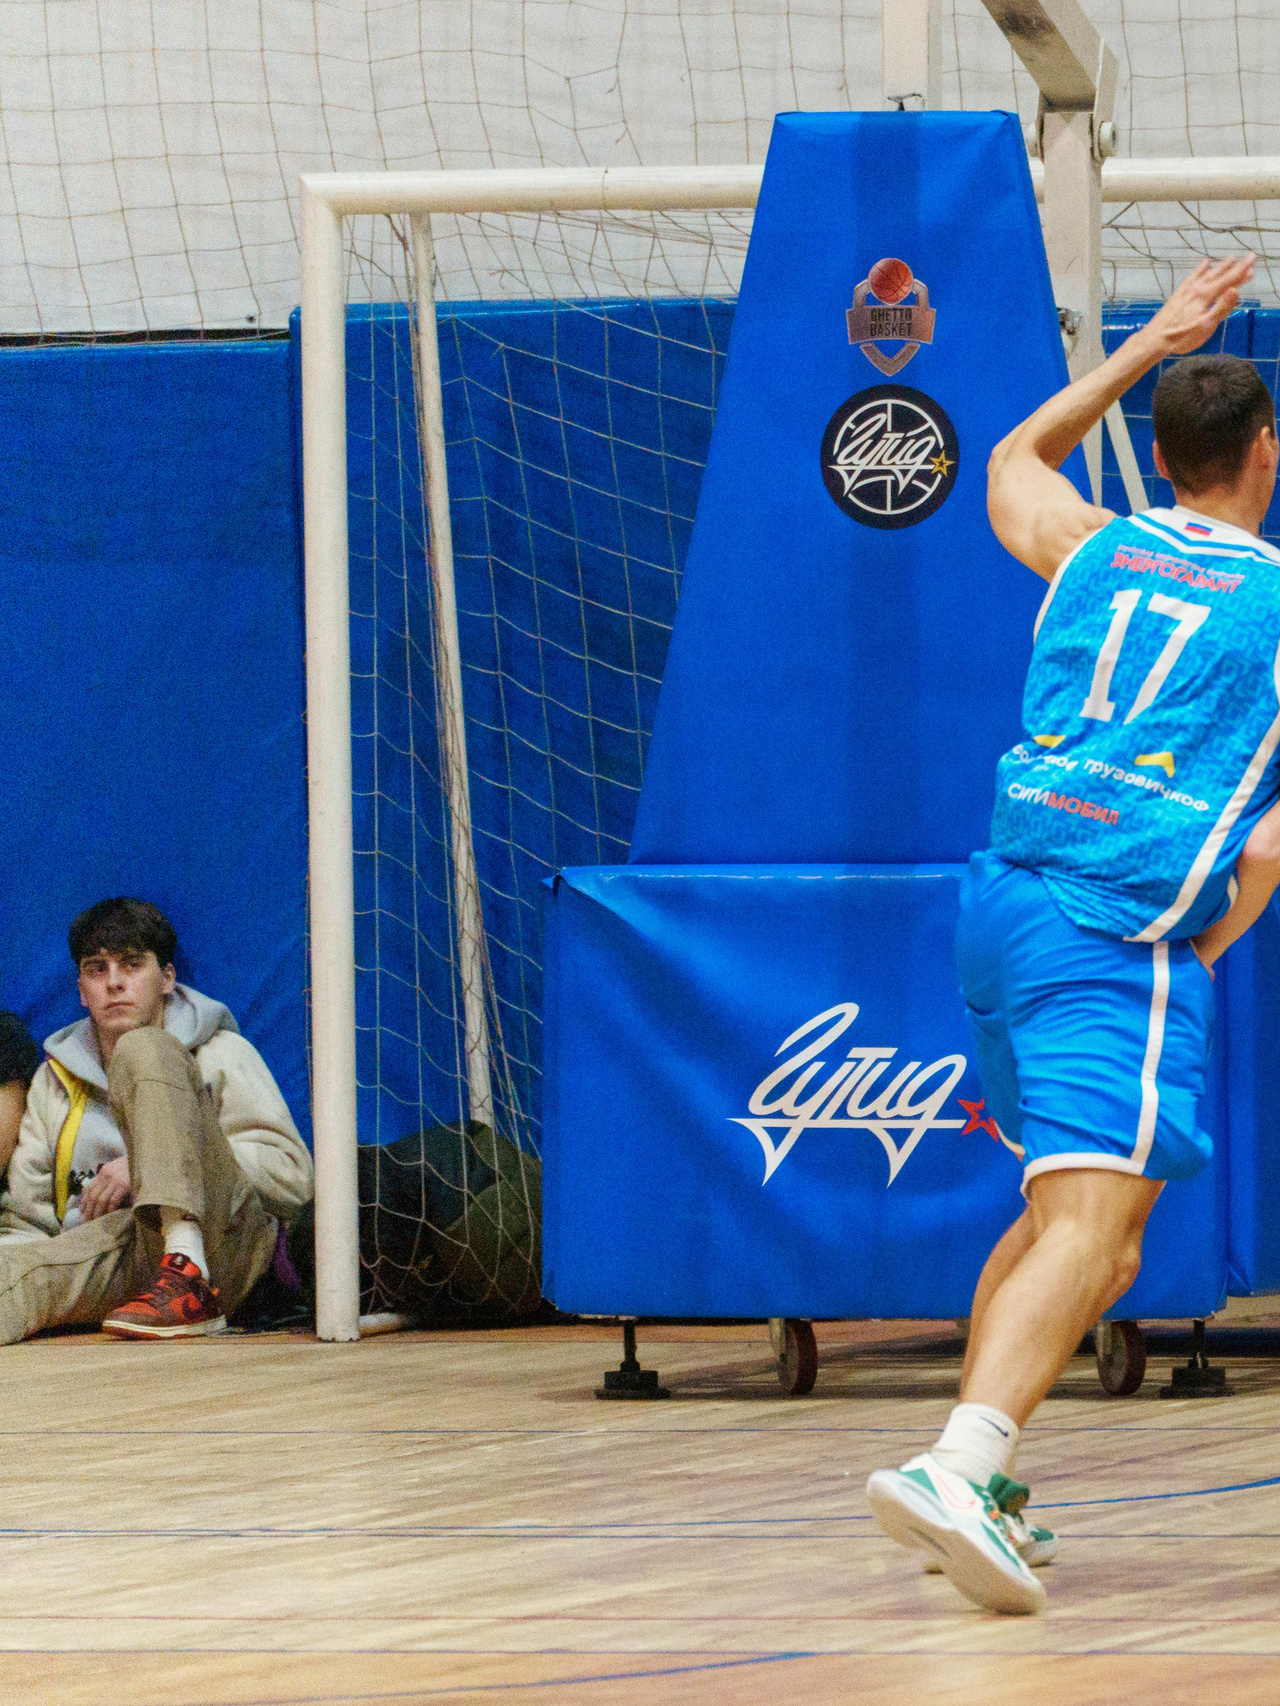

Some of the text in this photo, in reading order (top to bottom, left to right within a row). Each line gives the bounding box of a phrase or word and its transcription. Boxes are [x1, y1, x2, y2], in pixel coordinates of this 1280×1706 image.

[870, 307, 912, 322] GHETTO
[869, 322, 913, 337] BASKET
[1079, 589, 1211, 725] 17
